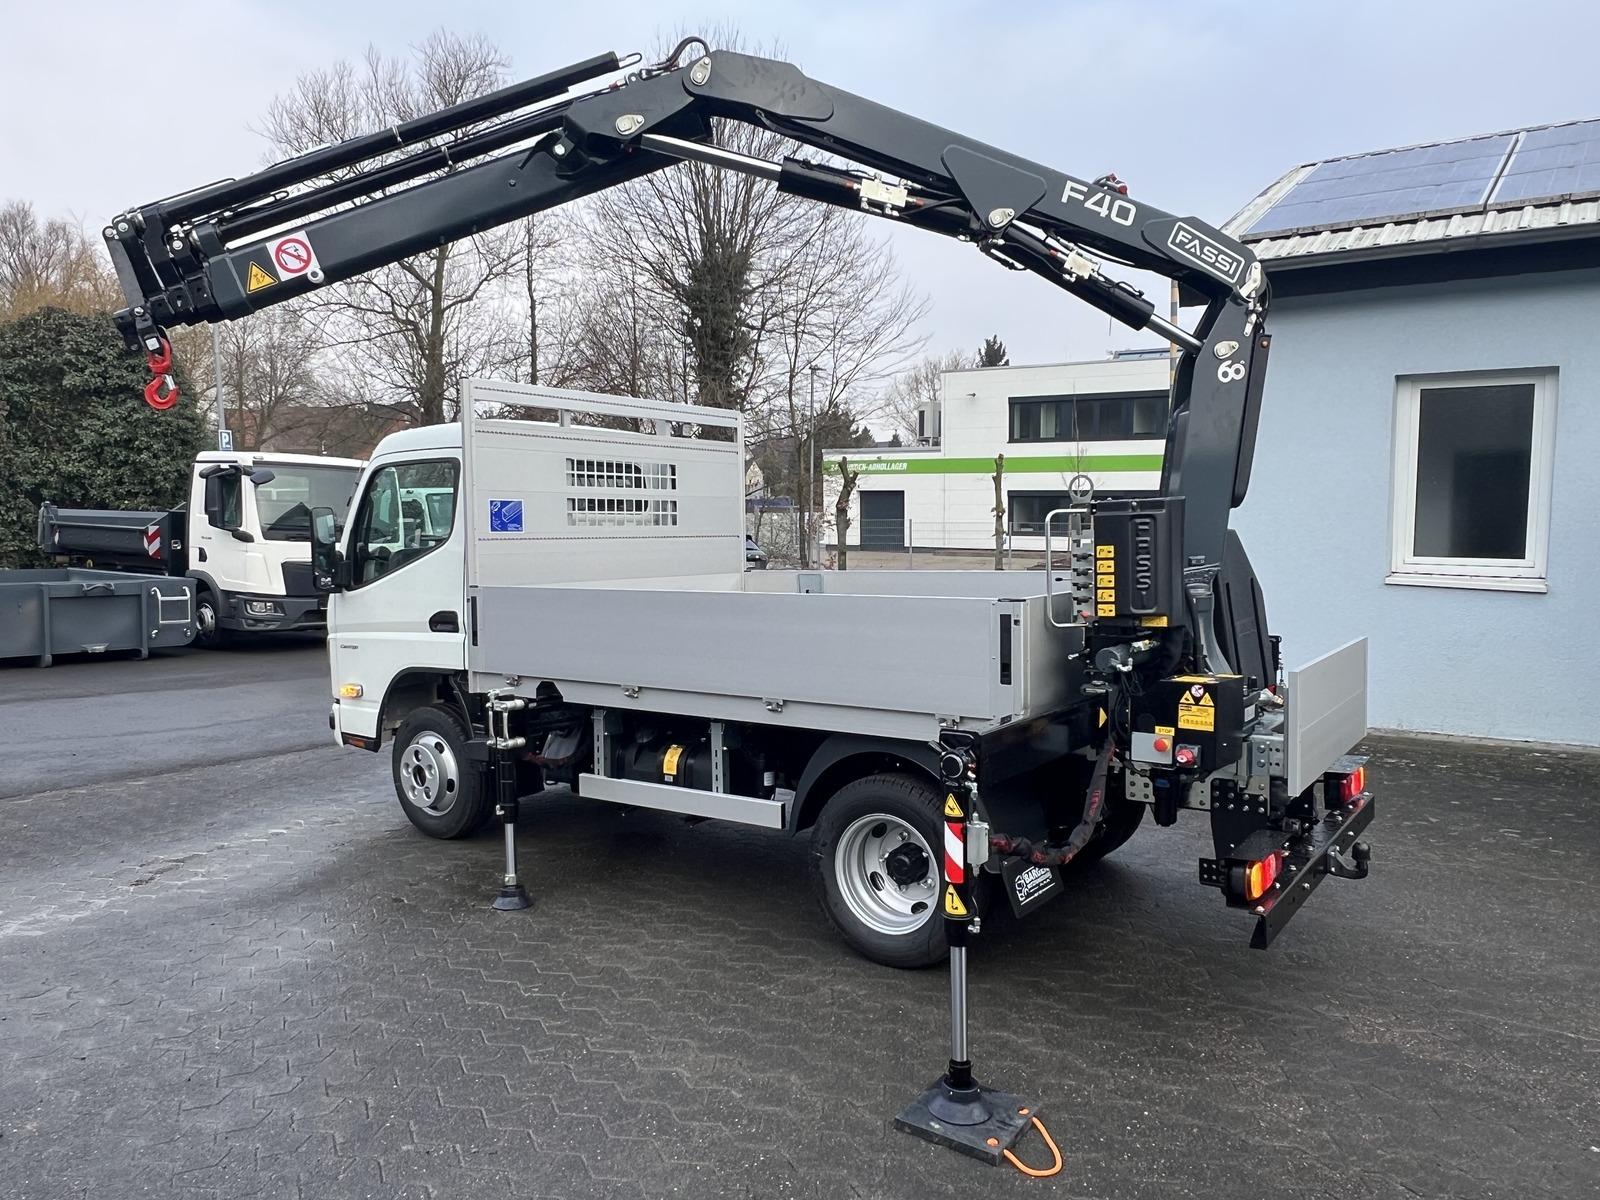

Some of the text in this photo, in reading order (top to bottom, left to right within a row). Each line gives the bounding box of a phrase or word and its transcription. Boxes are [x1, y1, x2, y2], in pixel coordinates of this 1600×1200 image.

[1061, 180, 1137, 226] F40
[1175, 230, 1237, 275] FASSI
[221, 433, 231, 448] P
